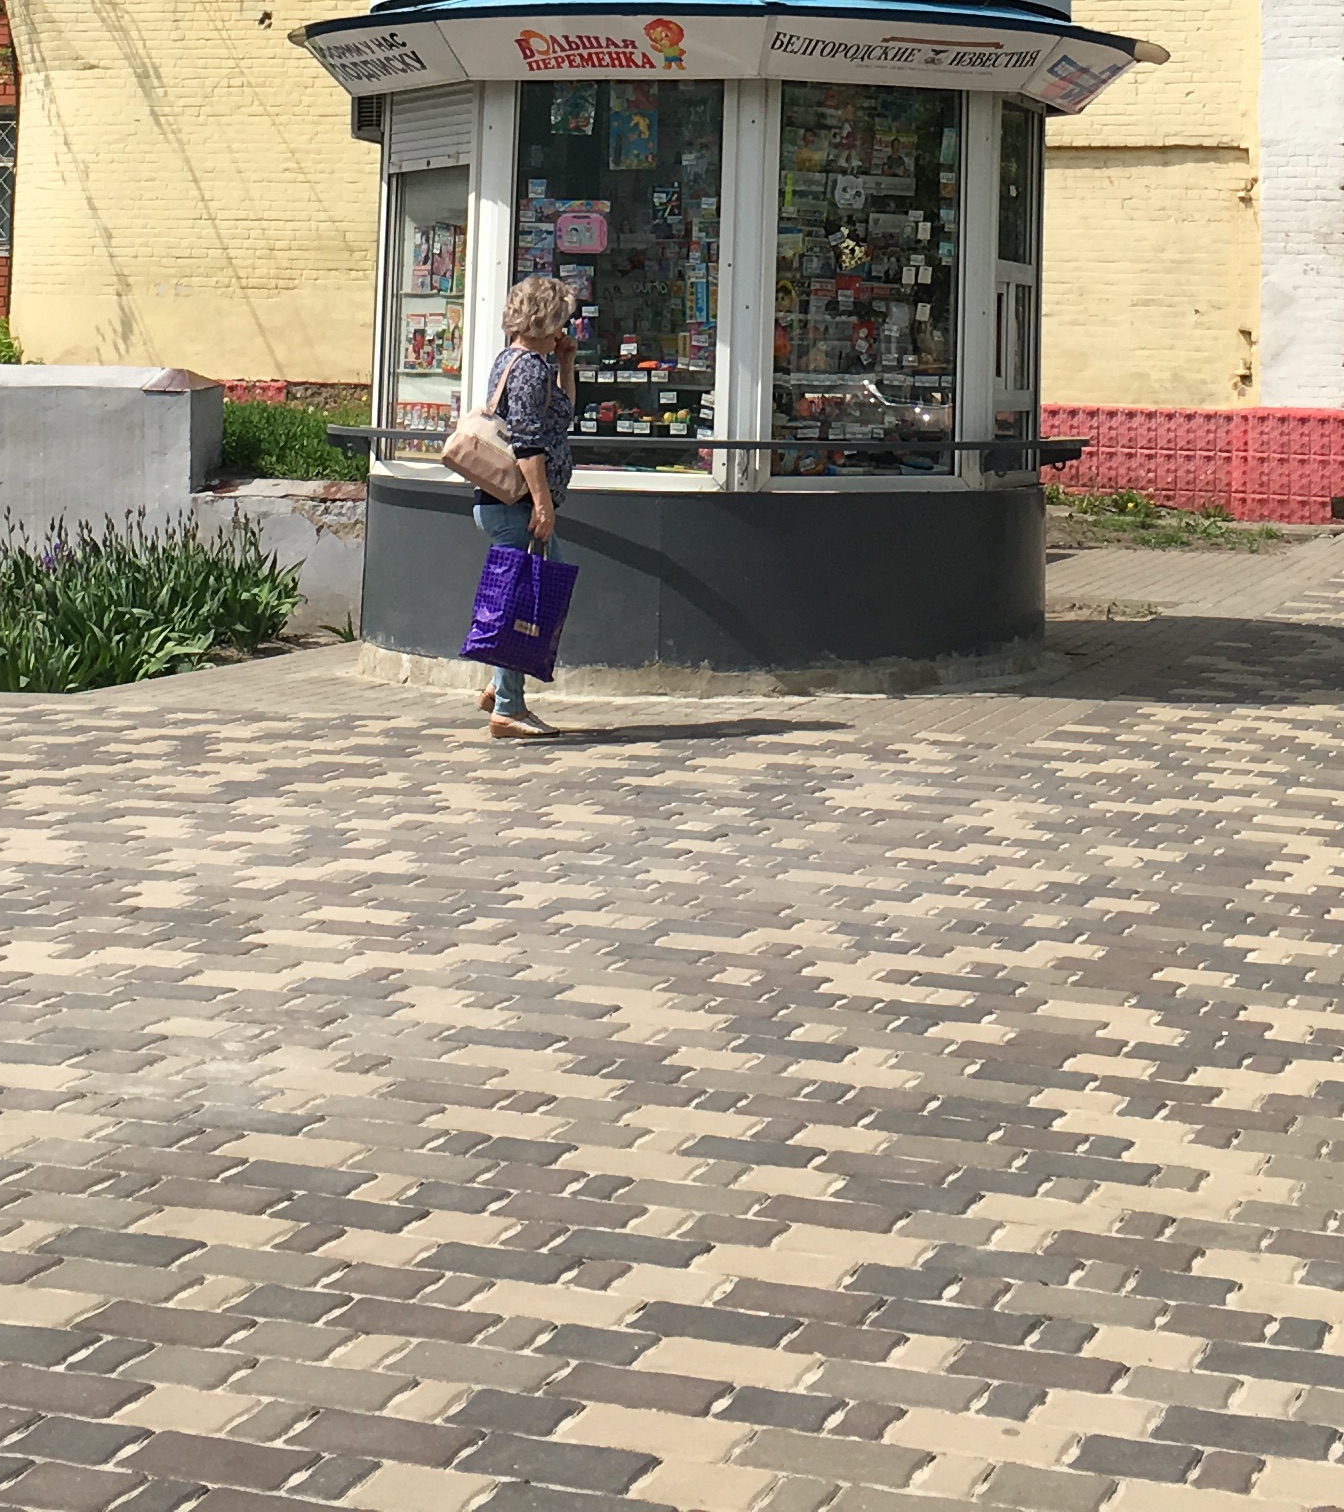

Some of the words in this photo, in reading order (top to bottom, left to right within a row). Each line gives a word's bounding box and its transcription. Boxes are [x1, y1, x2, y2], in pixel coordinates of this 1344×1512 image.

[369, 32, 408, 53] НАС
[770, 31, 922, 64] БЕЛГОРОДСКИЕ
[947, 48, 1043, 69] ИЗВЕСТИЯ
[328, 50, 428, 83] ПОДПИСКУ
[526, 51, 657, 72] ПЕРЕМЕНКА
